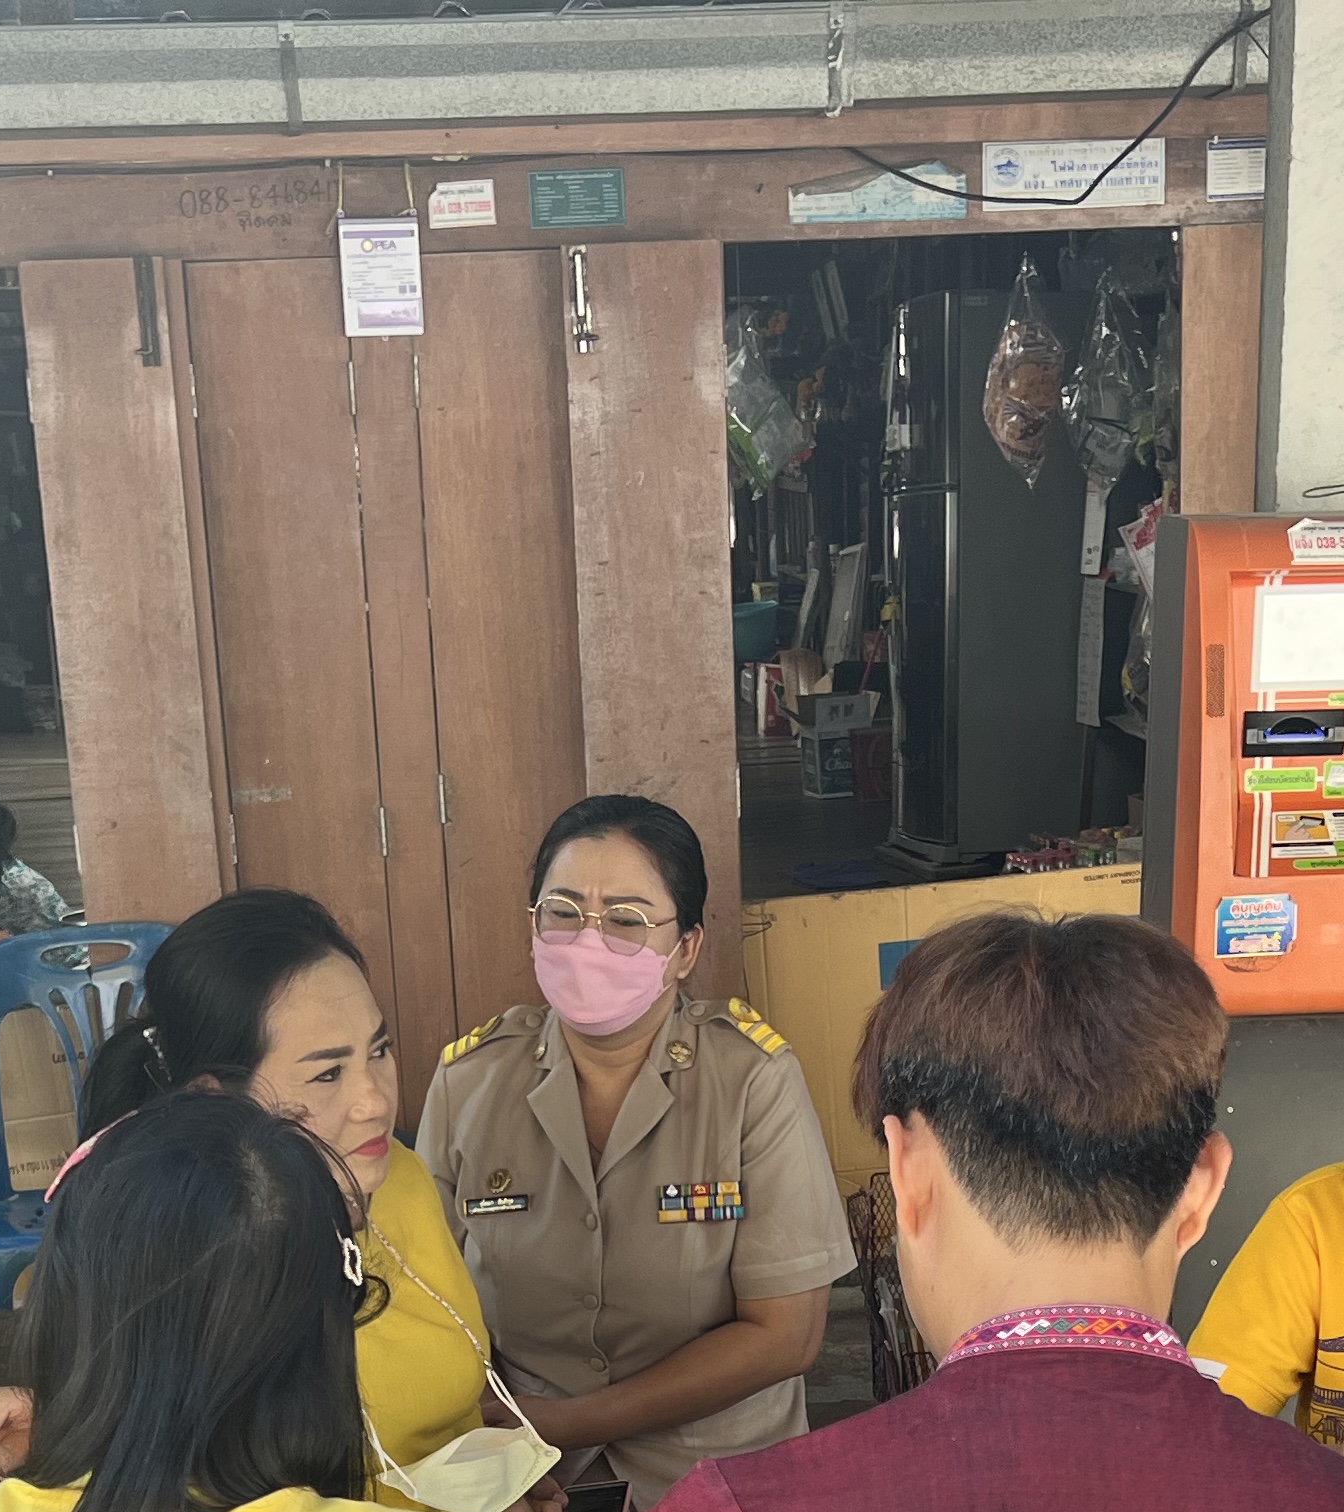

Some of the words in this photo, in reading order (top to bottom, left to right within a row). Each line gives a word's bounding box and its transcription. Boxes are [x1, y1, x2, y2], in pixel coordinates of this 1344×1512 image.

[1294, 534, 1313, 549] แจ้ง
[1231, 899, 1283, 918] ตู้บุญเติม
